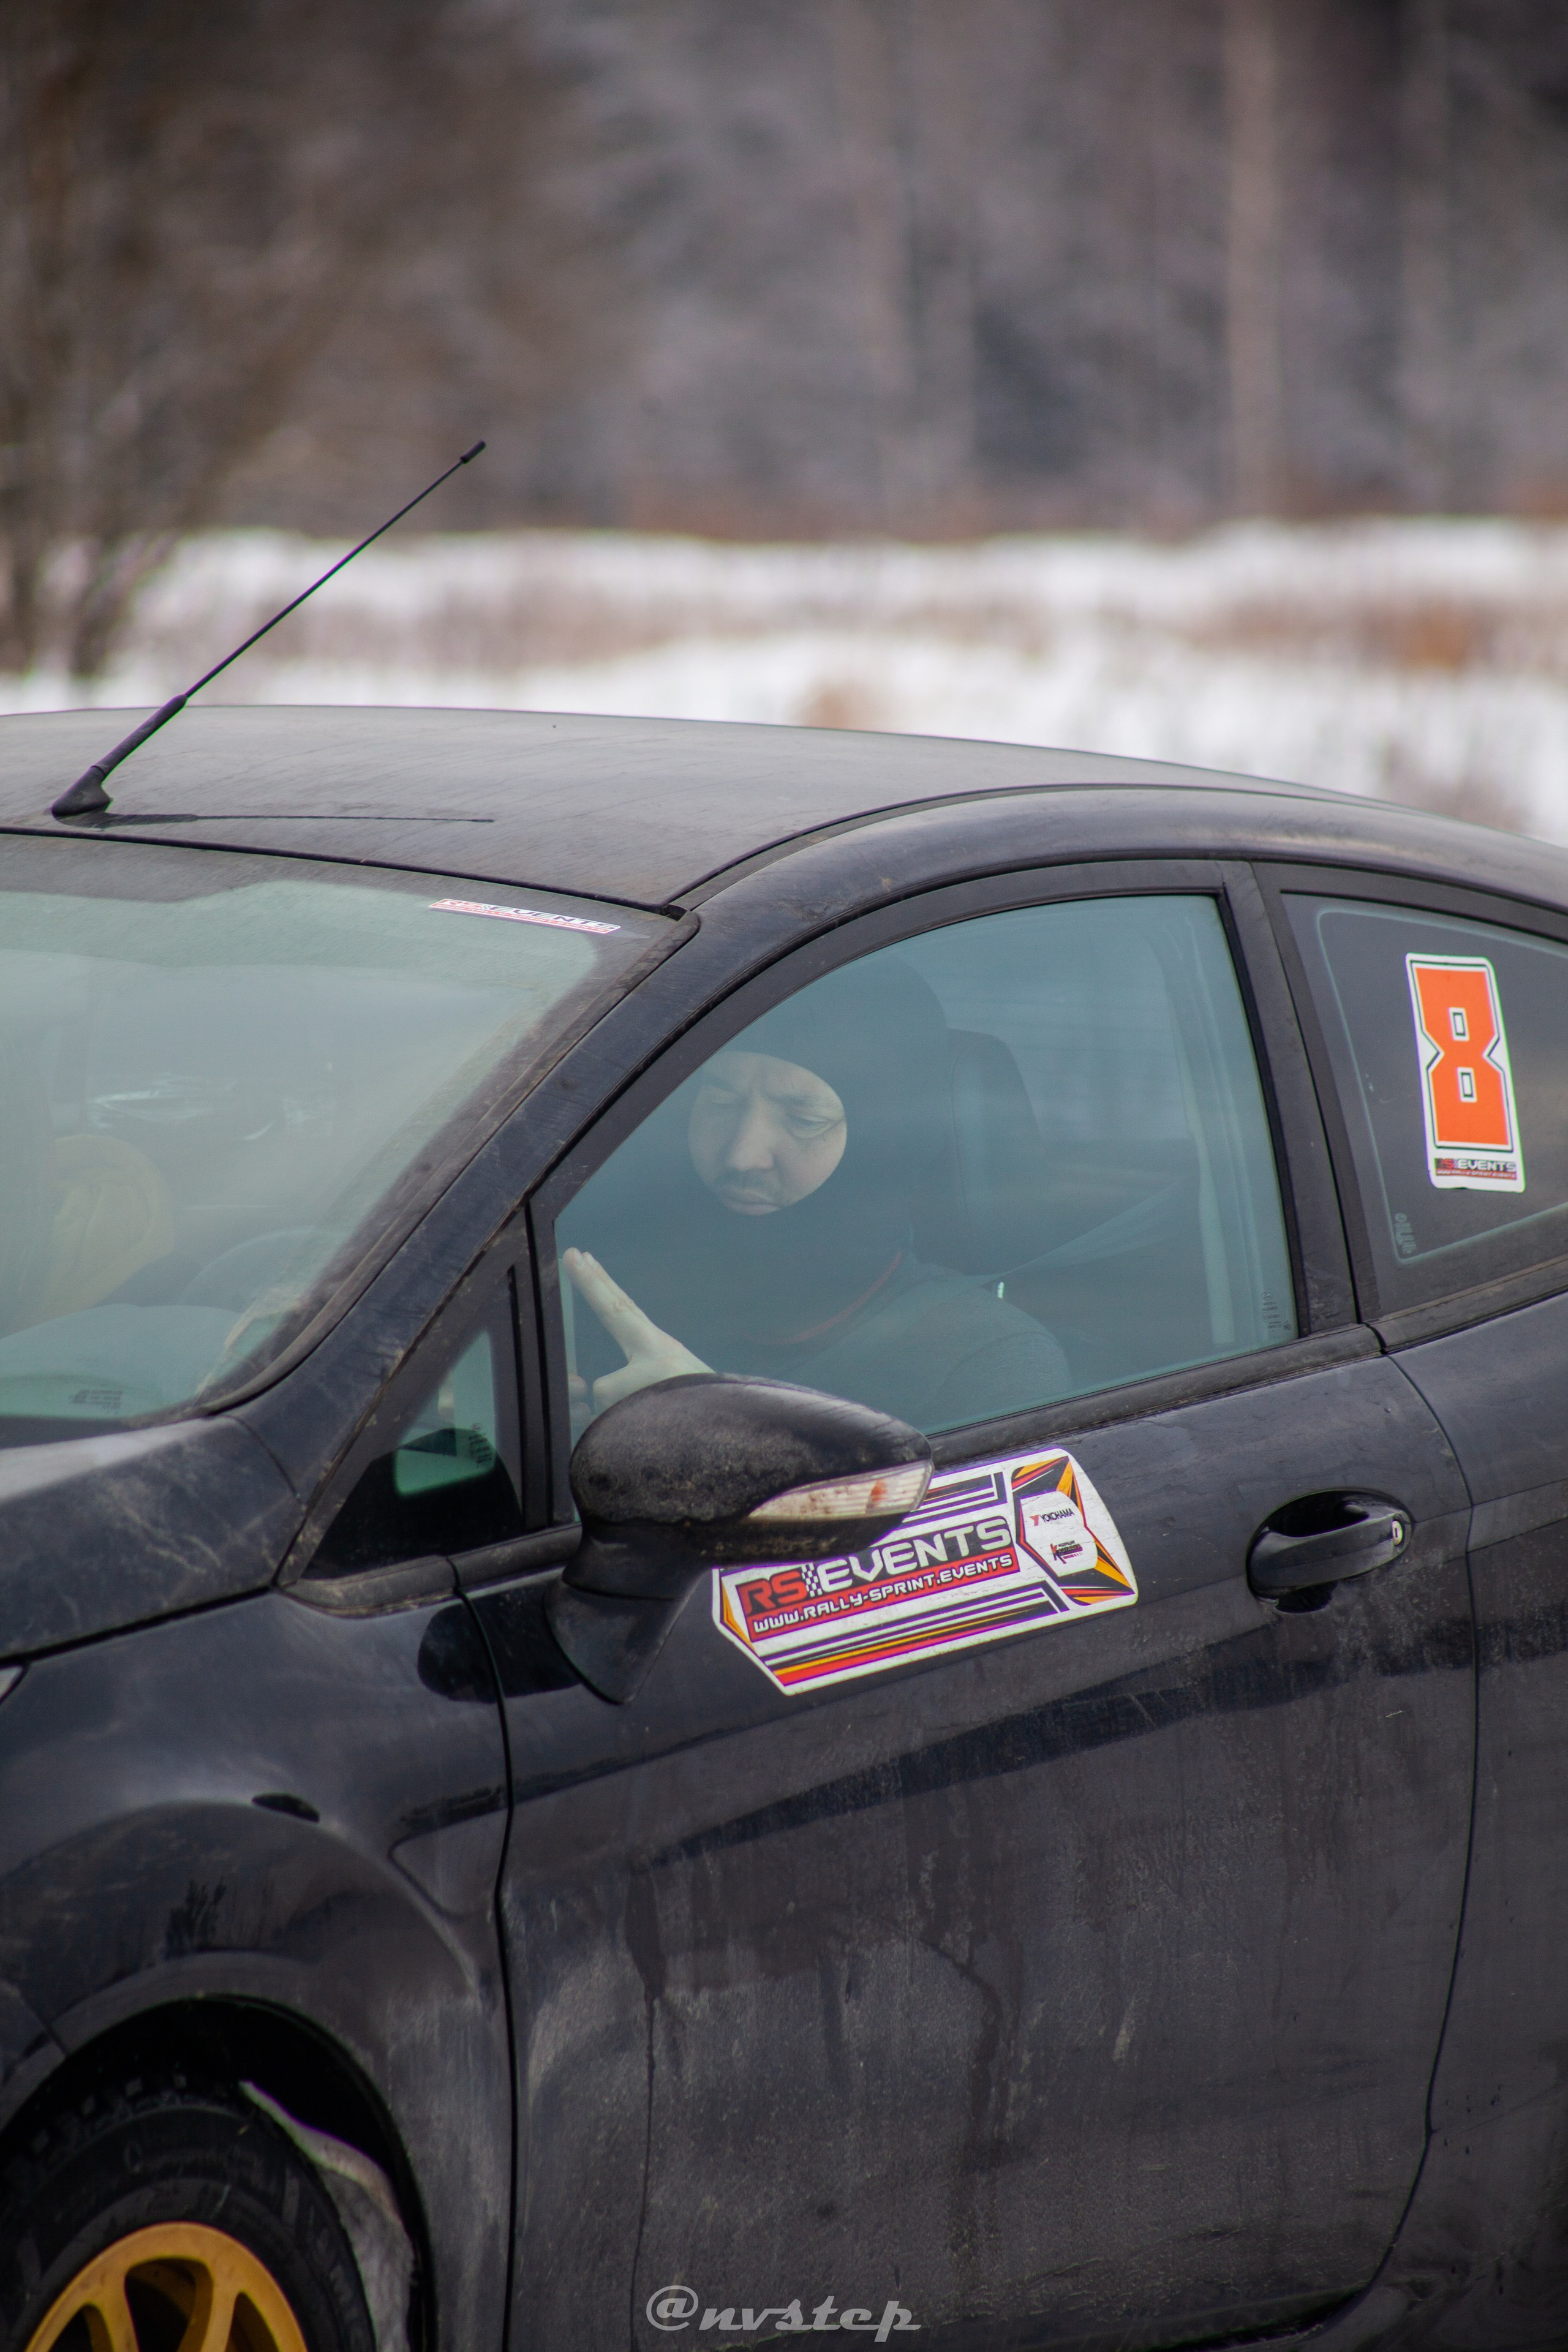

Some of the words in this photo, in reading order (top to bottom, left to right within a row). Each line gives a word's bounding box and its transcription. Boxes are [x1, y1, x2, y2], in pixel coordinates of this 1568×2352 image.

[438, 899, 481, 909] RS
[489, 906, 617, 930] EVENTS
[1412, 963, 1511, 1149] 8
[1458, 1158, 1517, 1173] EVENTS
[1041, 1508, 1075, 1523] YOKOHAMA
[739, 1570, 808, 1615] RS
[816, 1518, 1011, 1593] EVENTS
[753, 1555, 1012, 1633] WWW.RALLY-SPRINT.EVENTS
